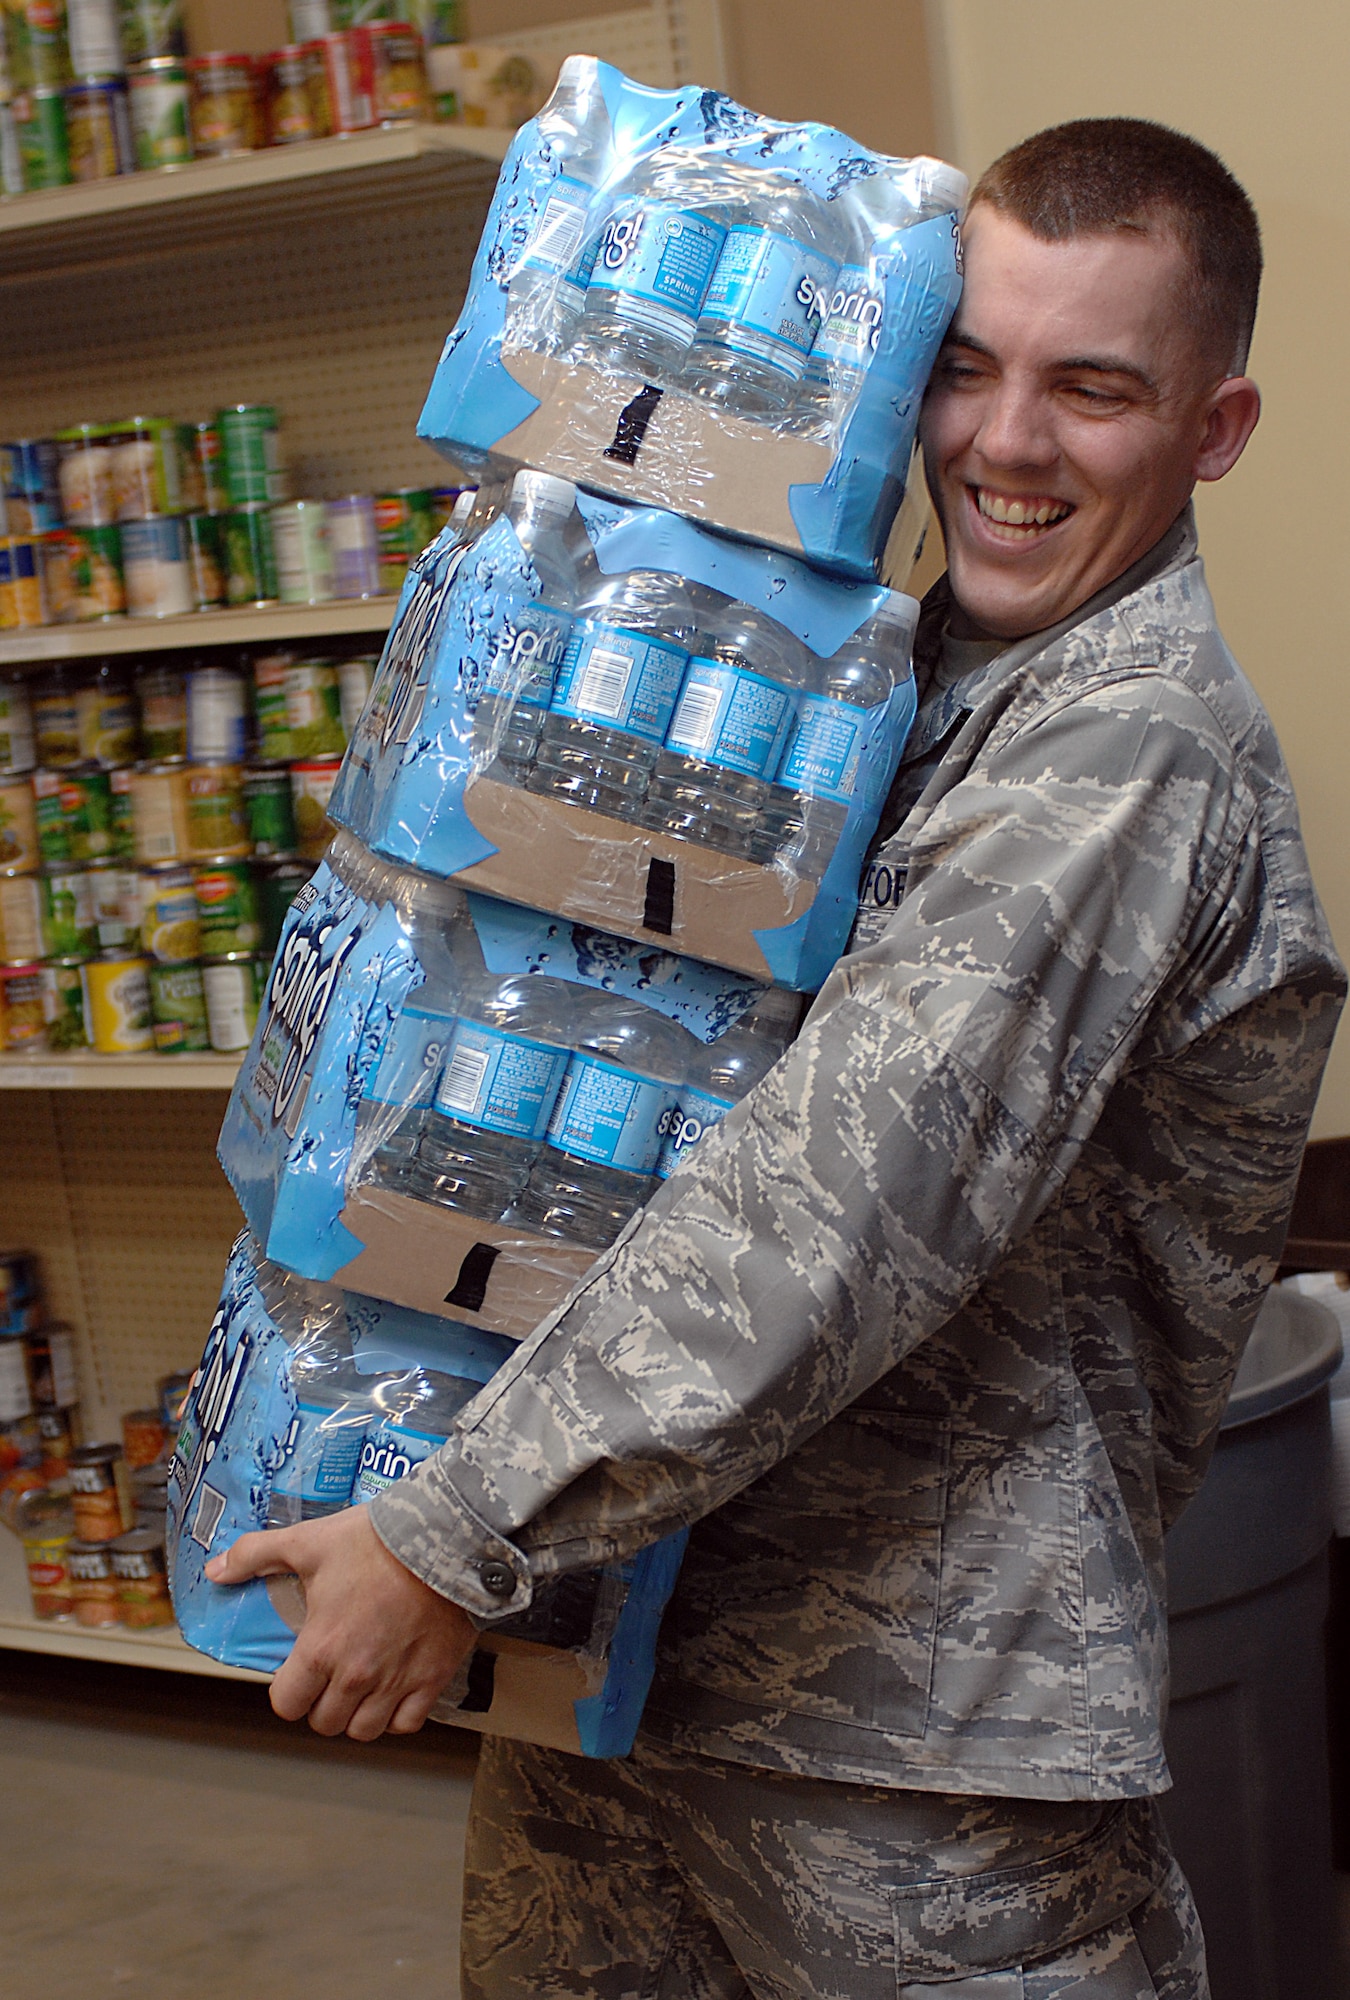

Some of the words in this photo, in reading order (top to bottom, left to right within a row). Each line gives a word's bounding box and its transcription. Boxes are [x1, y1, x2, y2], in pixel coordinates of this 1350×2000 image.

[663, 275, 699, 298] SPRING!
[794, 759, 835, 779] SPRING!
[362, 1472, 391, 1489] natural
